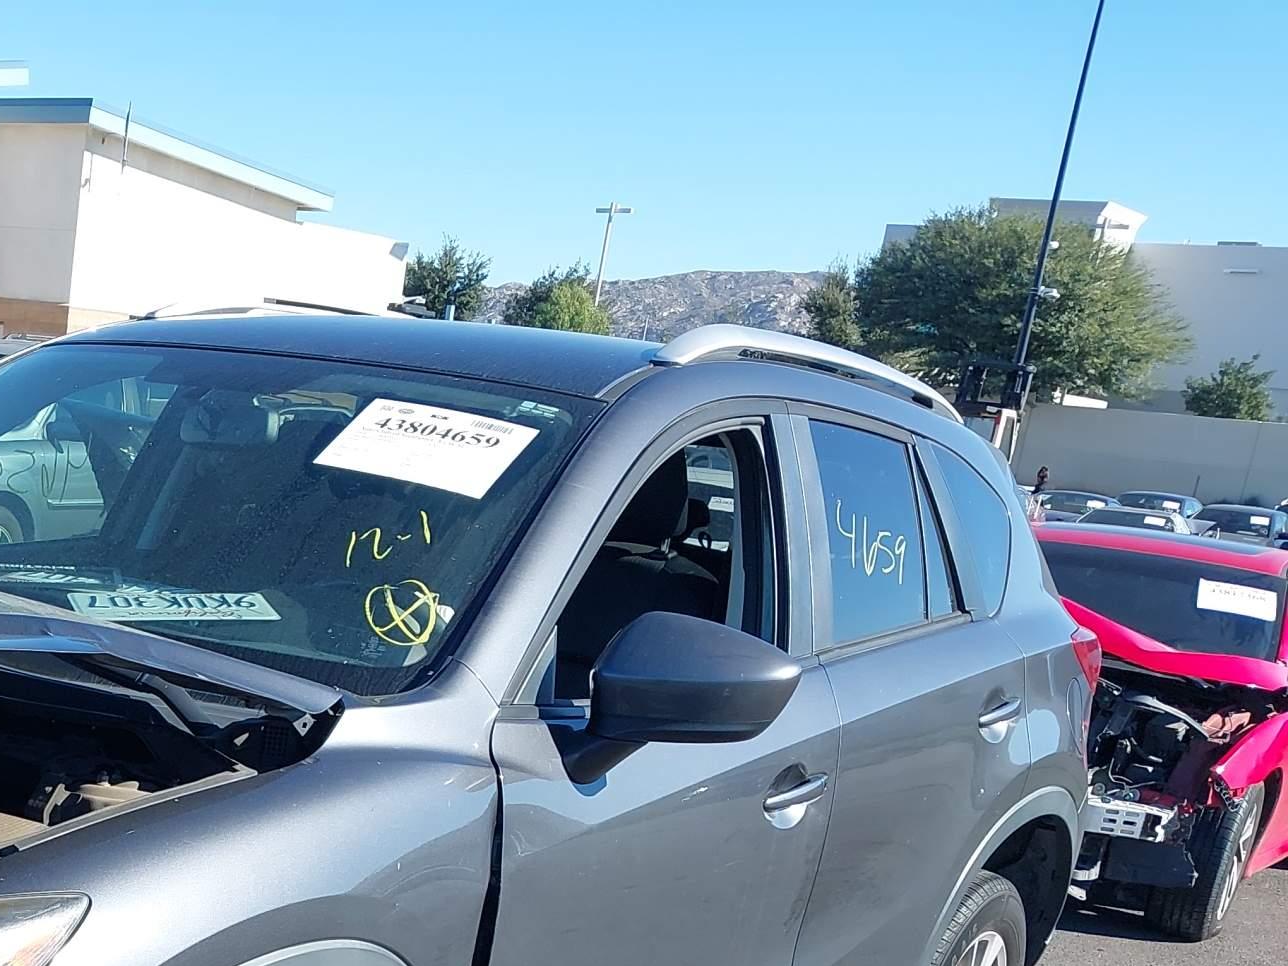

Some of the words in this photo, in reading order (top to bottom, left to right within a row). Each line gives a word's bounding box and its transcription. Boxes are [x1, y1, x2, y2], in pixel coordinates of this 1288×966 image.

[374, 416, 501, 449] 43804659
[344, 509, 431, 568] 12-1
[835, 499, 907, 585] 4659
[88, 594, 258, 610] 9KUK307
